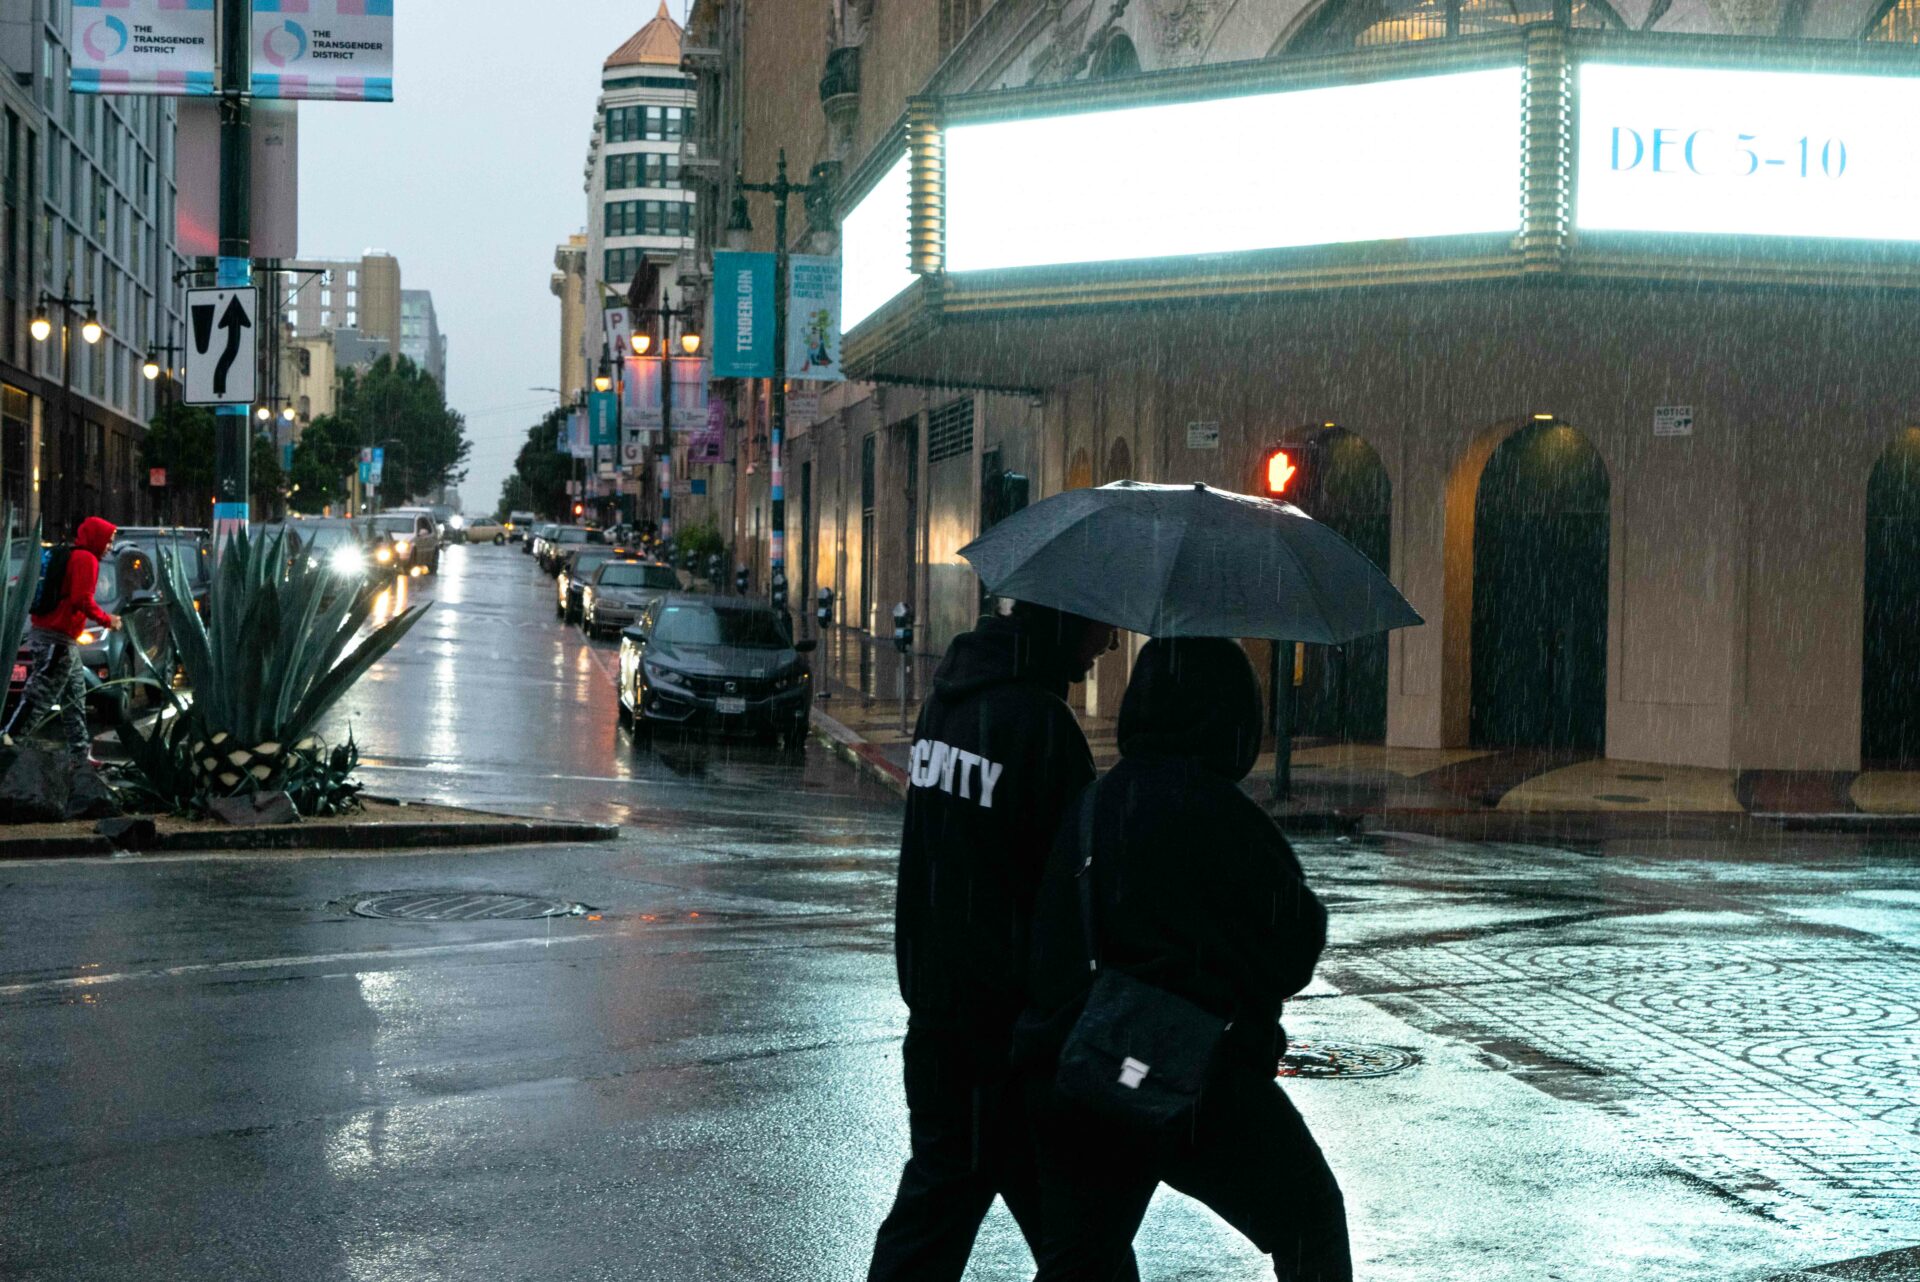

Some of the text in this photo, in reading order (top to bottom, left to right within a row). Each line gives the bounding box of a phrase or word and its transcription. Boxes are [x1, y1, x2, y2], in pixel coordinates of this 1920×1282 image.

[133, 25, 153, 33] THE
[312, 30, 331, 38] THE
[133, 35, 205, 44] TRANSGENDER
[133, 45, 176, 54] DISTRICT
[312, 40, 383, 50] TRANSGENDER
[312, 51, 355, 59] DISTRICT
[1610, 126, 1848, 180] DEC 5-10
[737, 269, 753, 353] TENDERLOIN
[1656, 407, 1691, 417] NOTICE
